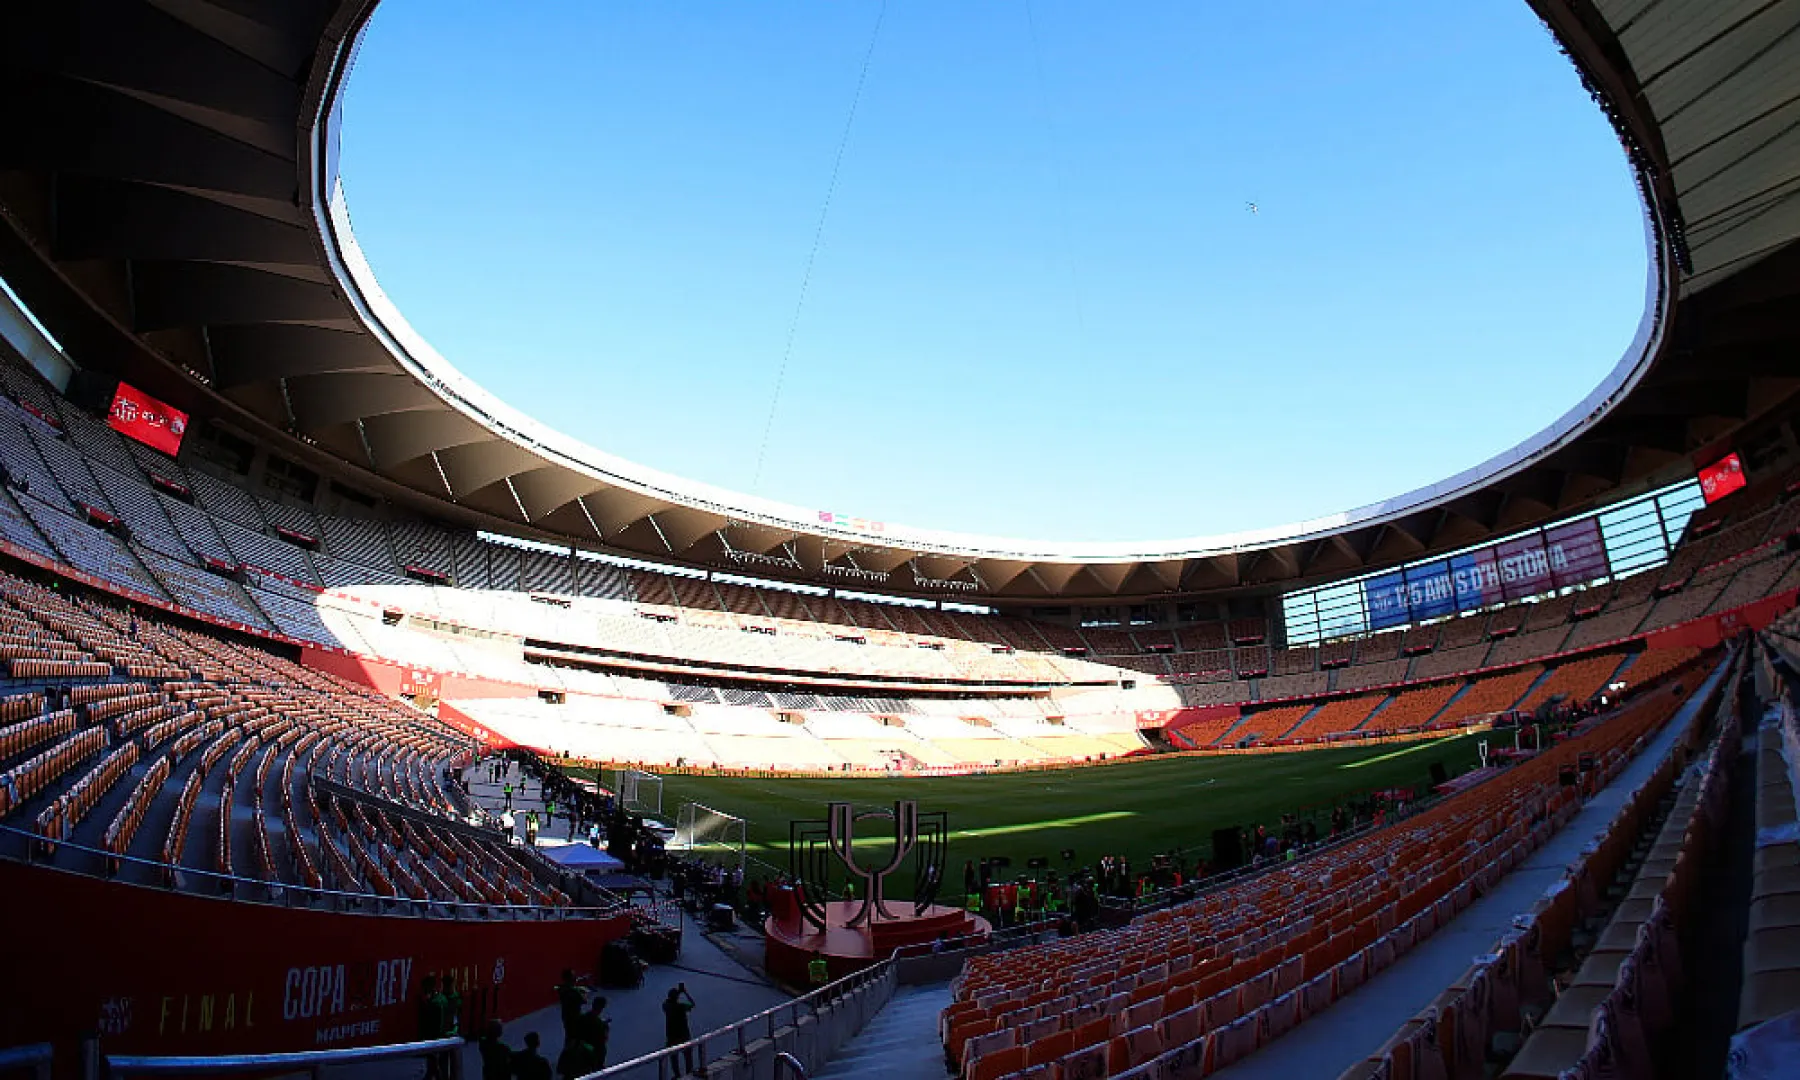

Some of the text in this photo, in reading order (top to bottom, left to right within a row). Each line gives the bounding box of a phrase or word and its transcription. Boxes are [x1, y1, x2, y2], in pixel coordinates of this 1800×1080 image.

[1395, 582, 1422, 608] 125
[1425, 571, 1468, 602] ANYS
[283, 956, 413, 1020] COPA REY
[159, 990, 255, 1036] FINAL
